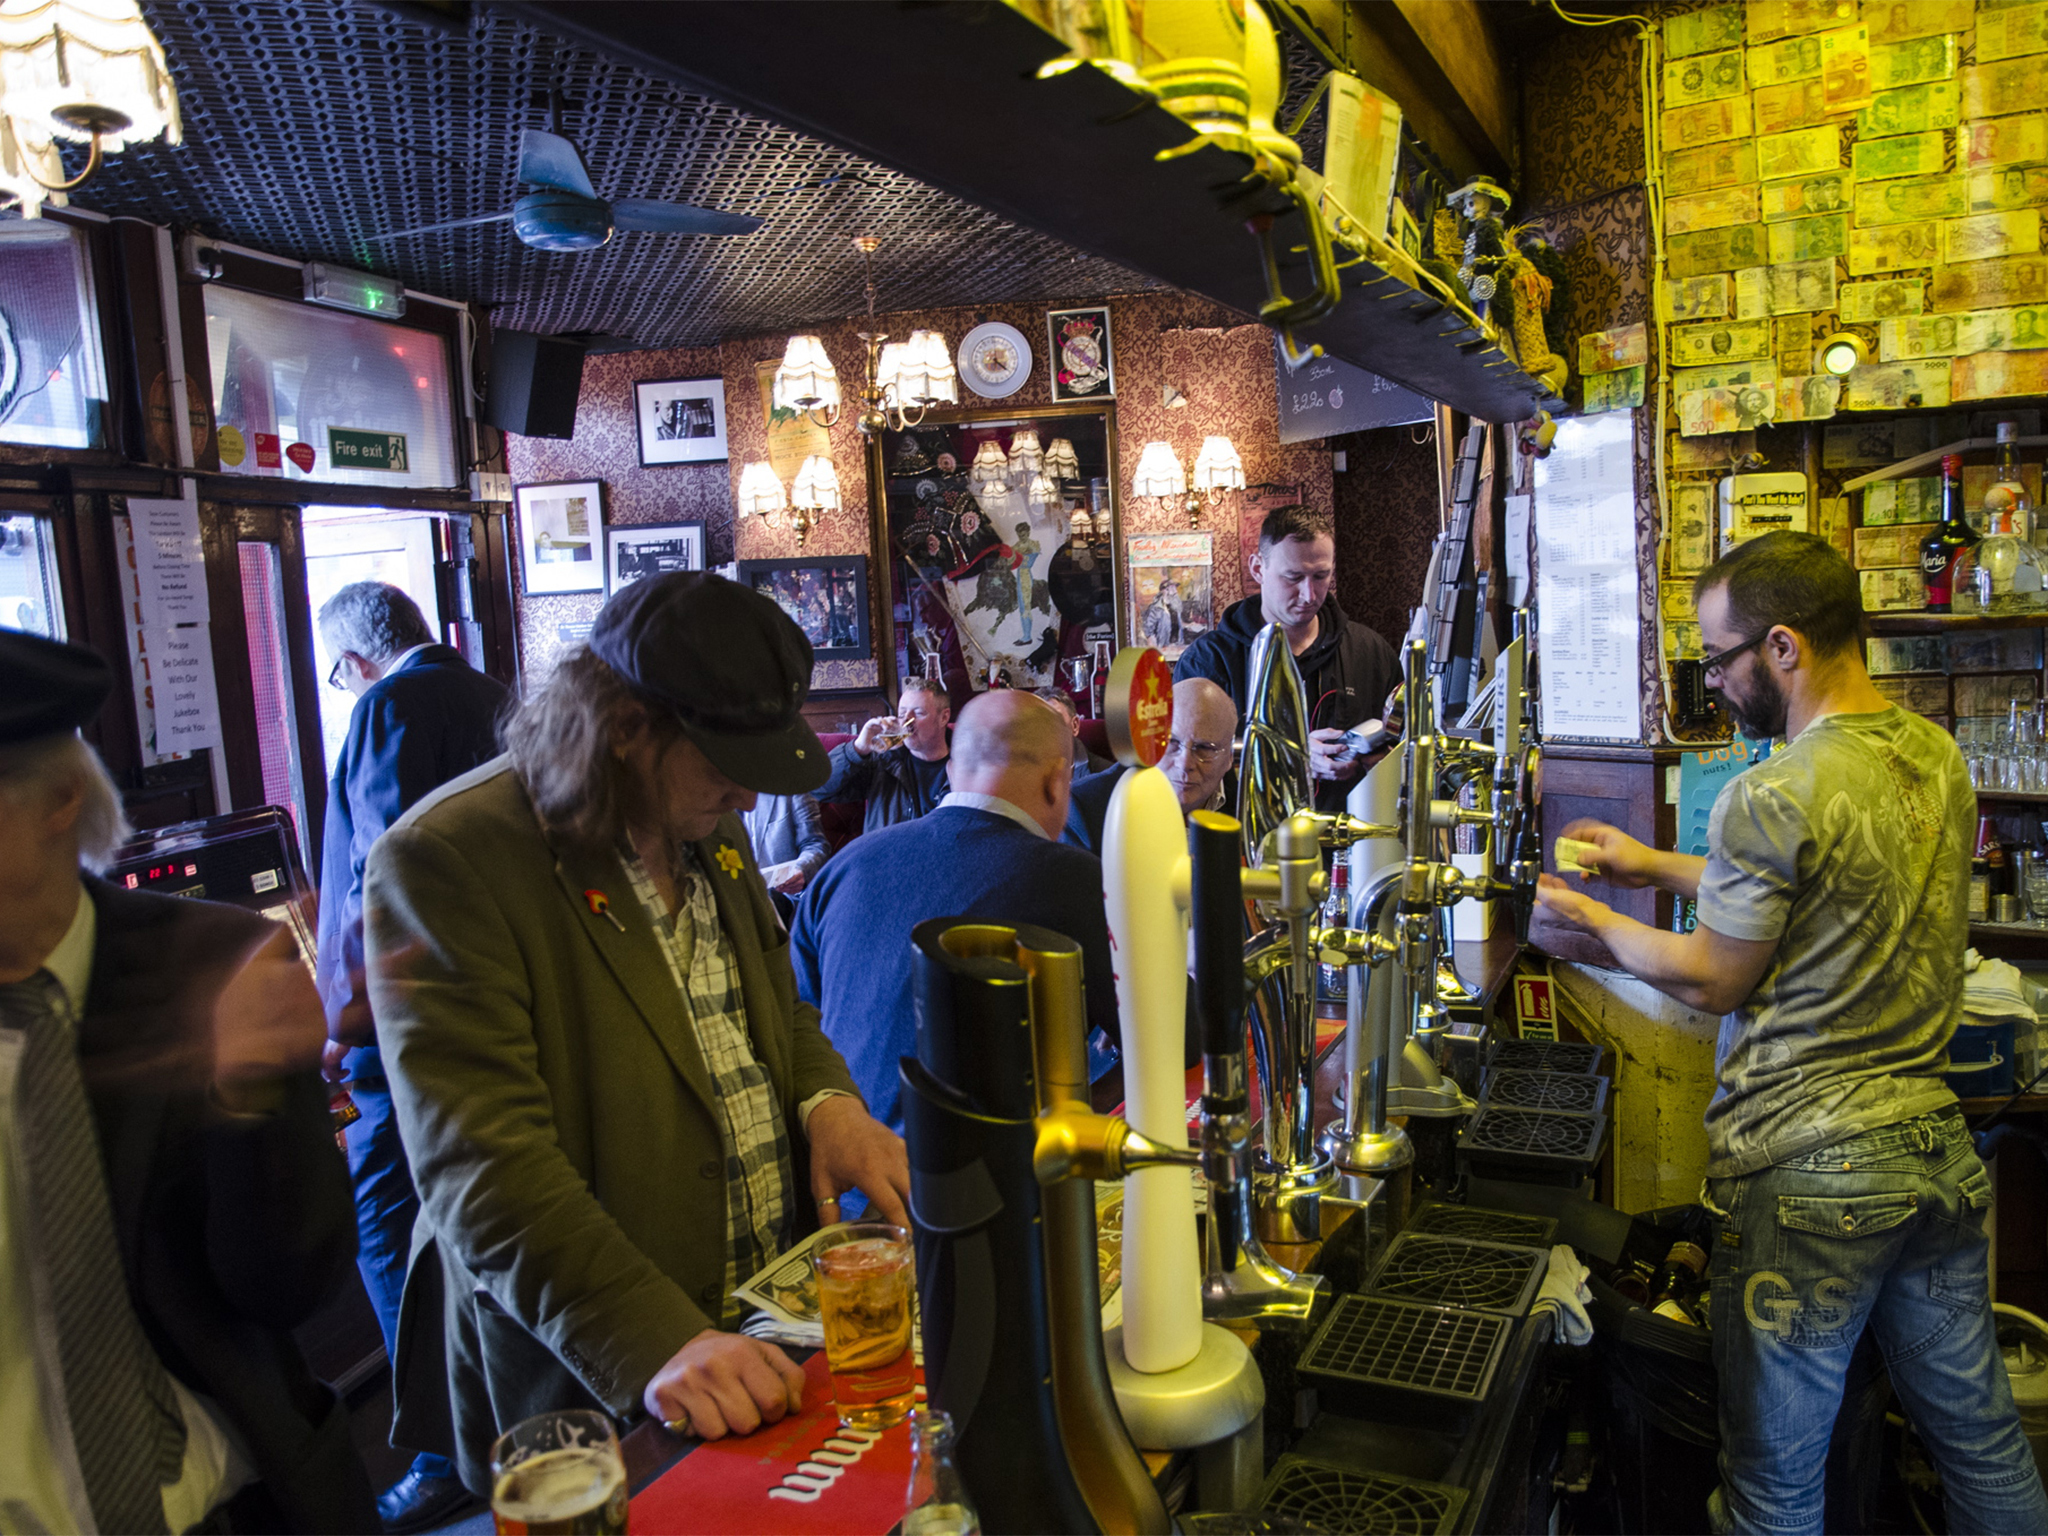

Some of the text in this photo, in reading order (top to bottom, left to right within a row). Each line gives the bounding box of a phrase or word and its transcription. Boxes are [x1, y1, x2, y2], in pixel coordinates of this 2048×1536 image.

[1852, 55, 1867, 73] 10
[1890, 69, 1909, 82] 50
[1932, 114, 1953, 127] 100
[1699, 232, 1720, 242] 200
[1843, 286, 1852, 298] 10
[1908, 341, 1923, 354] 10
[1924, 361, 1948, 369] 5000
[1691, 420, 1715, 434] 500
[335, 441, 383, 458] Fire exit
[168, 641, 189, 650] Please
[163, 657, 199, 668] Be Delicate
[168, 674, 198, 684] With Our
[175, 691, 196, 702] Lovely
[173, 708, 200, 718] Jukebox
[171, 723, 206, 735] Thank You
[1702, 763, 1732, 776] nuts!
